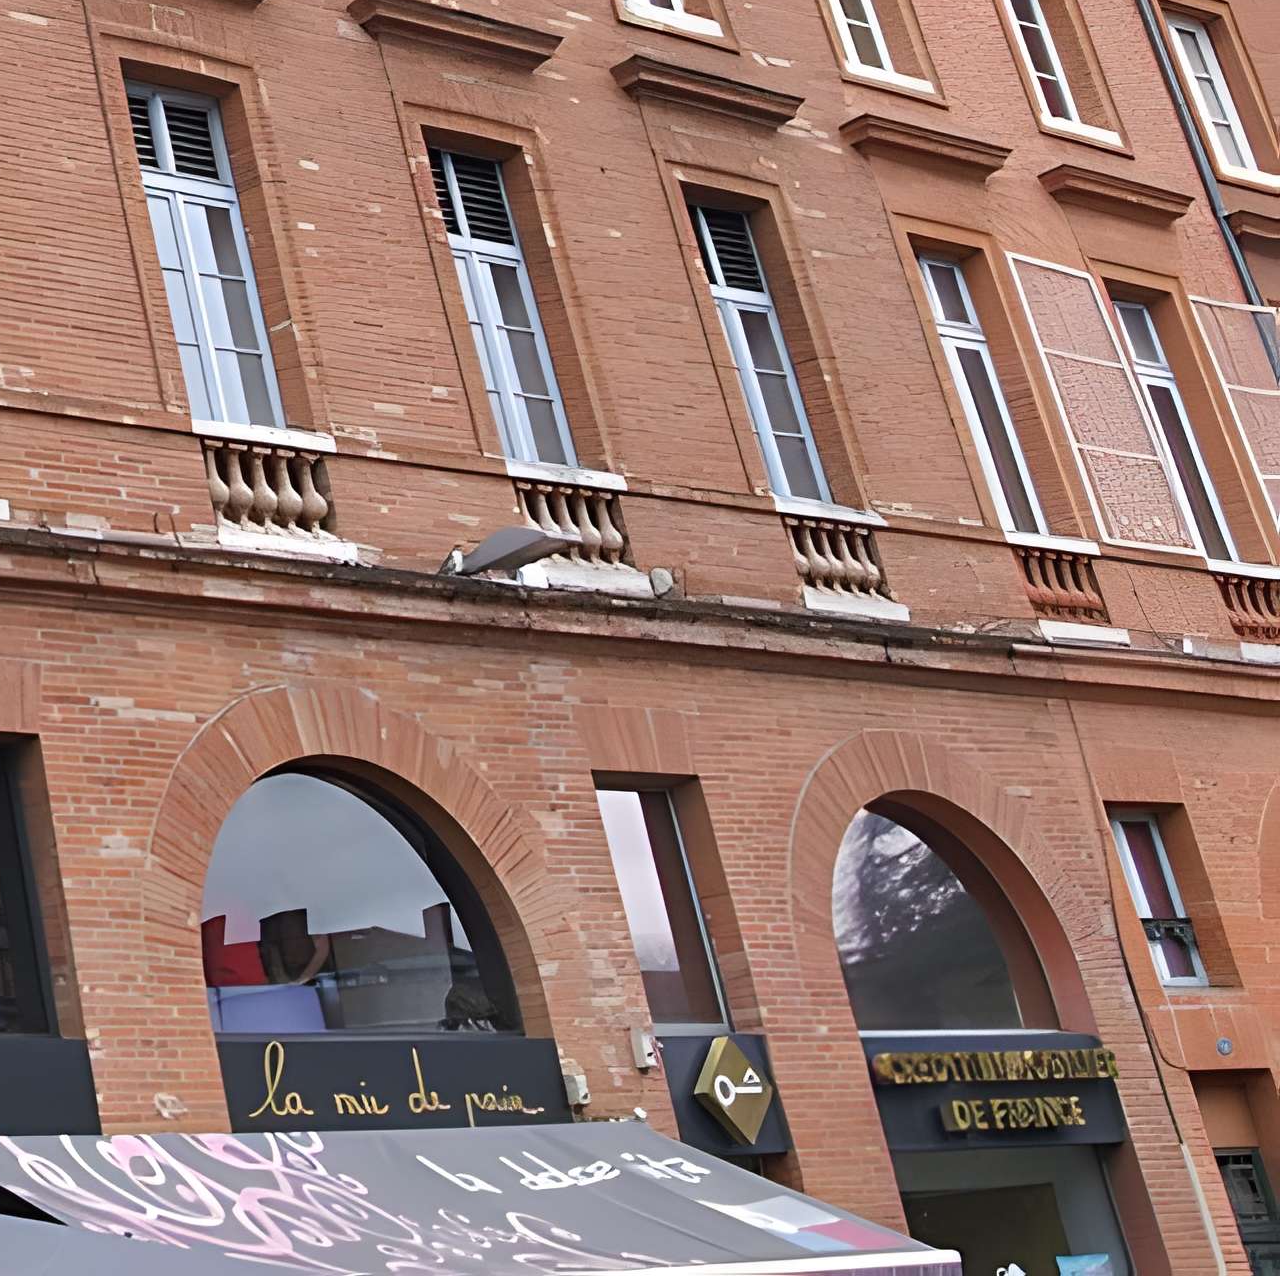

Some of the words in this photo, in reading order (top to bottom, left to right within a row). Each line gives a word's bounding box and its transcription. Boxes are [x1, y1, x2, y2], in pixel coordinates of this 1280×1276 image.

[248, 1040, 314, 1118] la
[408, 1046, 451, 1112] de
[948, 1098, 989, 1131] DE
